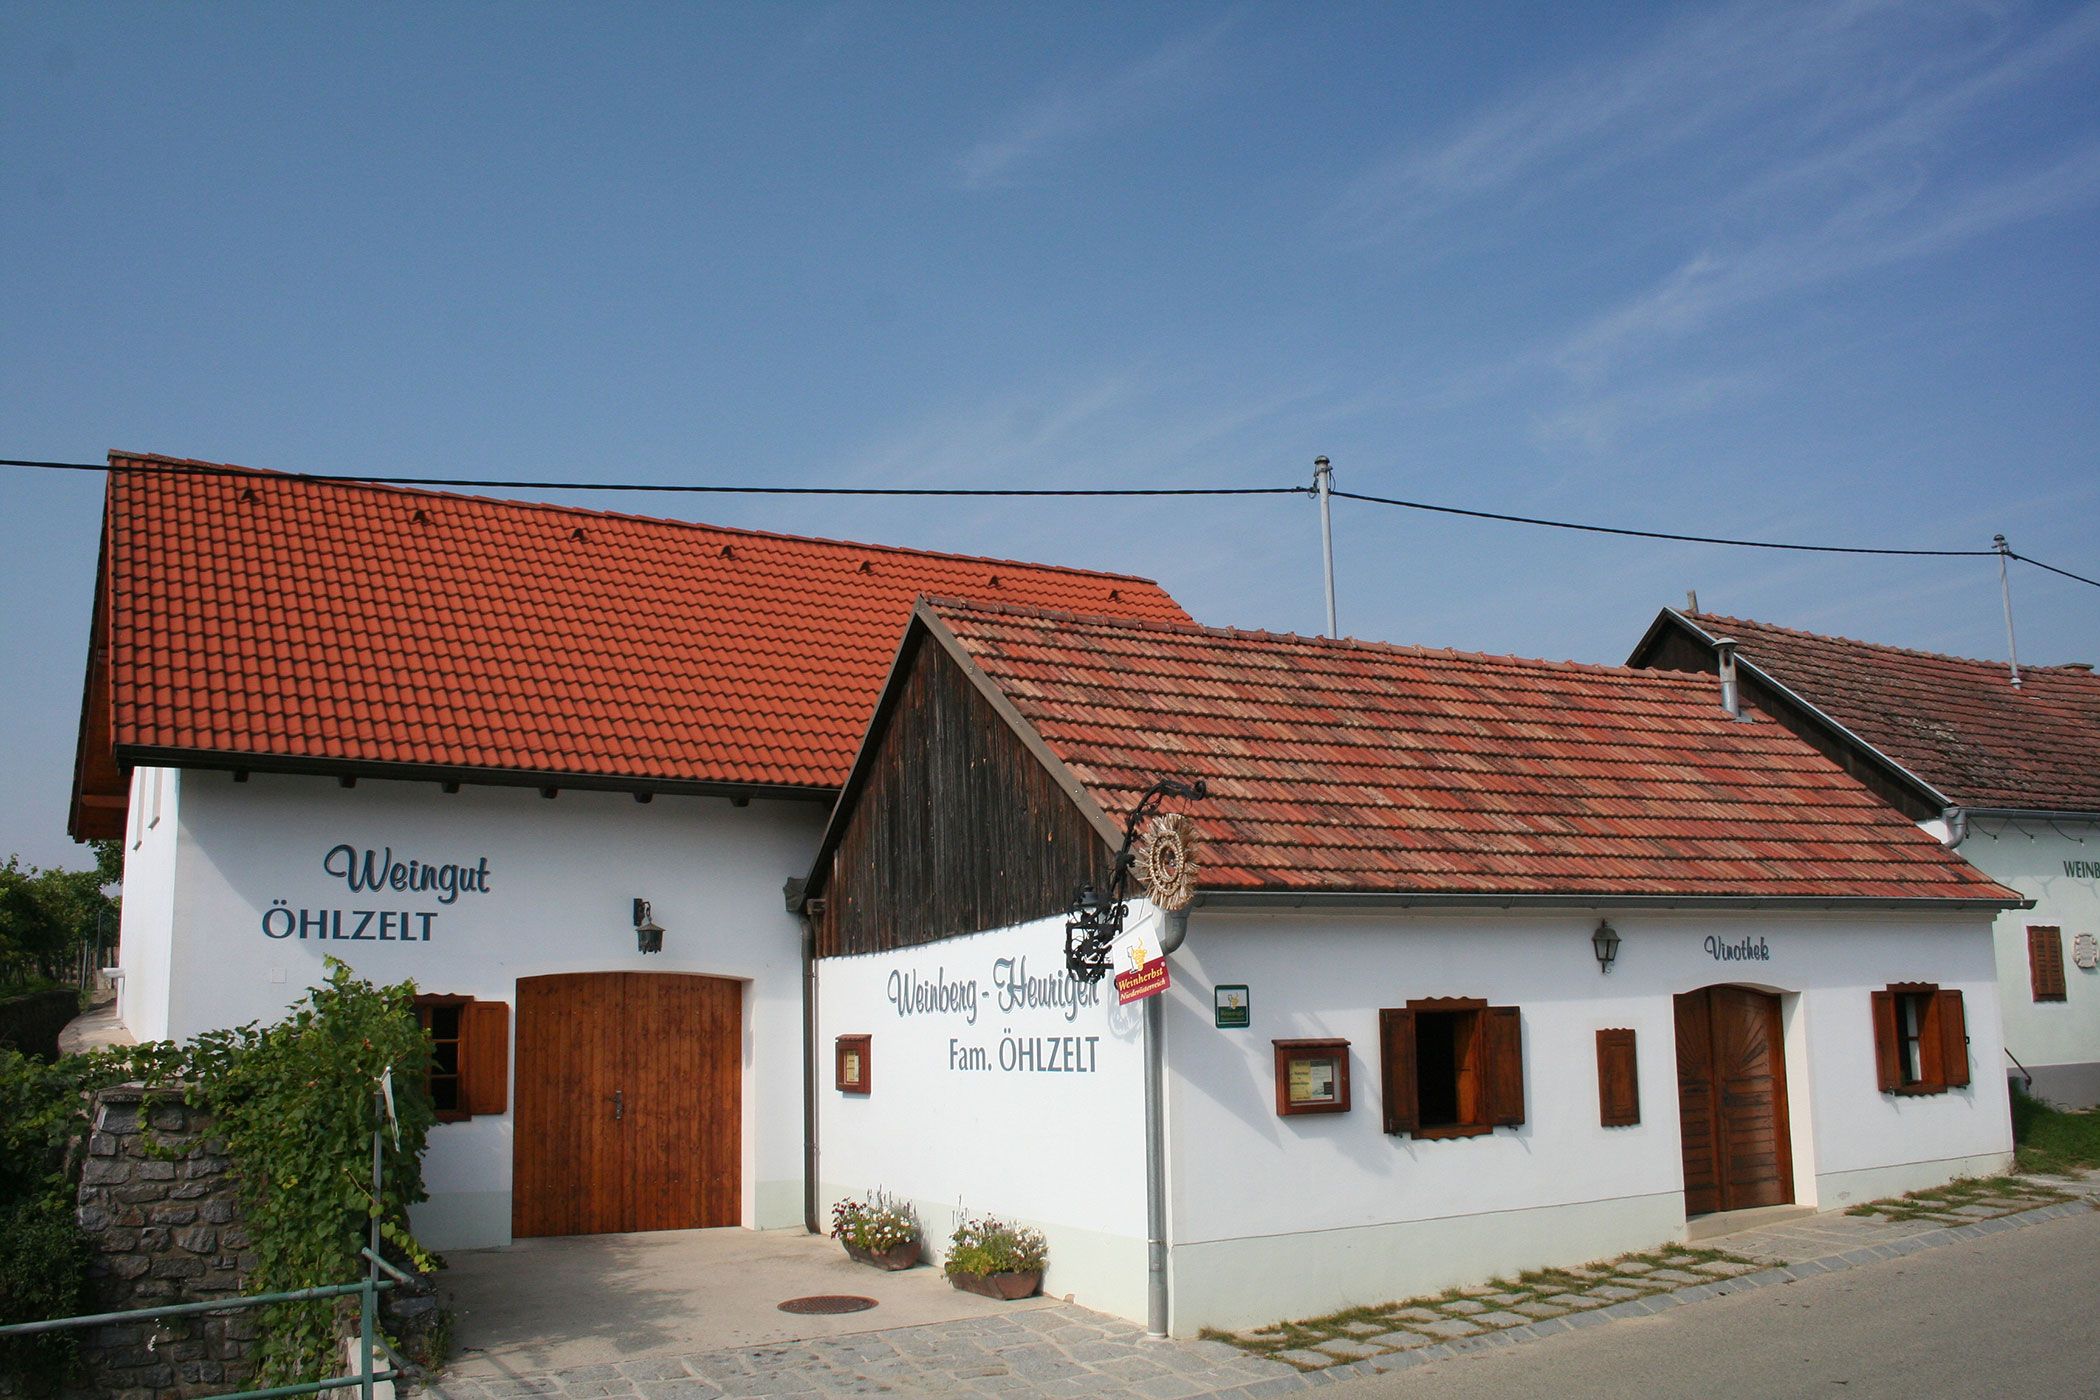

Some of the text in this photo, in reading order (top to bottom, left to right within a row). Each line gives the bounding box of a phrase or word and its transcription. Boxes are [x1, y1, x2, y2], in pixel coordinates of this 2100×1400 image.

[324, 844, 491, 905] Weingut
[2063, 860, 2100, 879] WEINB
[262, 899, 438, 941] ÖHLZELT
[1704, 935, 1770, 961] Vinothek
[887, 966, 978, 1026] Weinberg
[993, 955, 1100, 1022] Heurigen
[1119, 967, 1163, 992] Weinherbst
[949, 1028, 1099, 1072] Fam. ÖHLZELT
